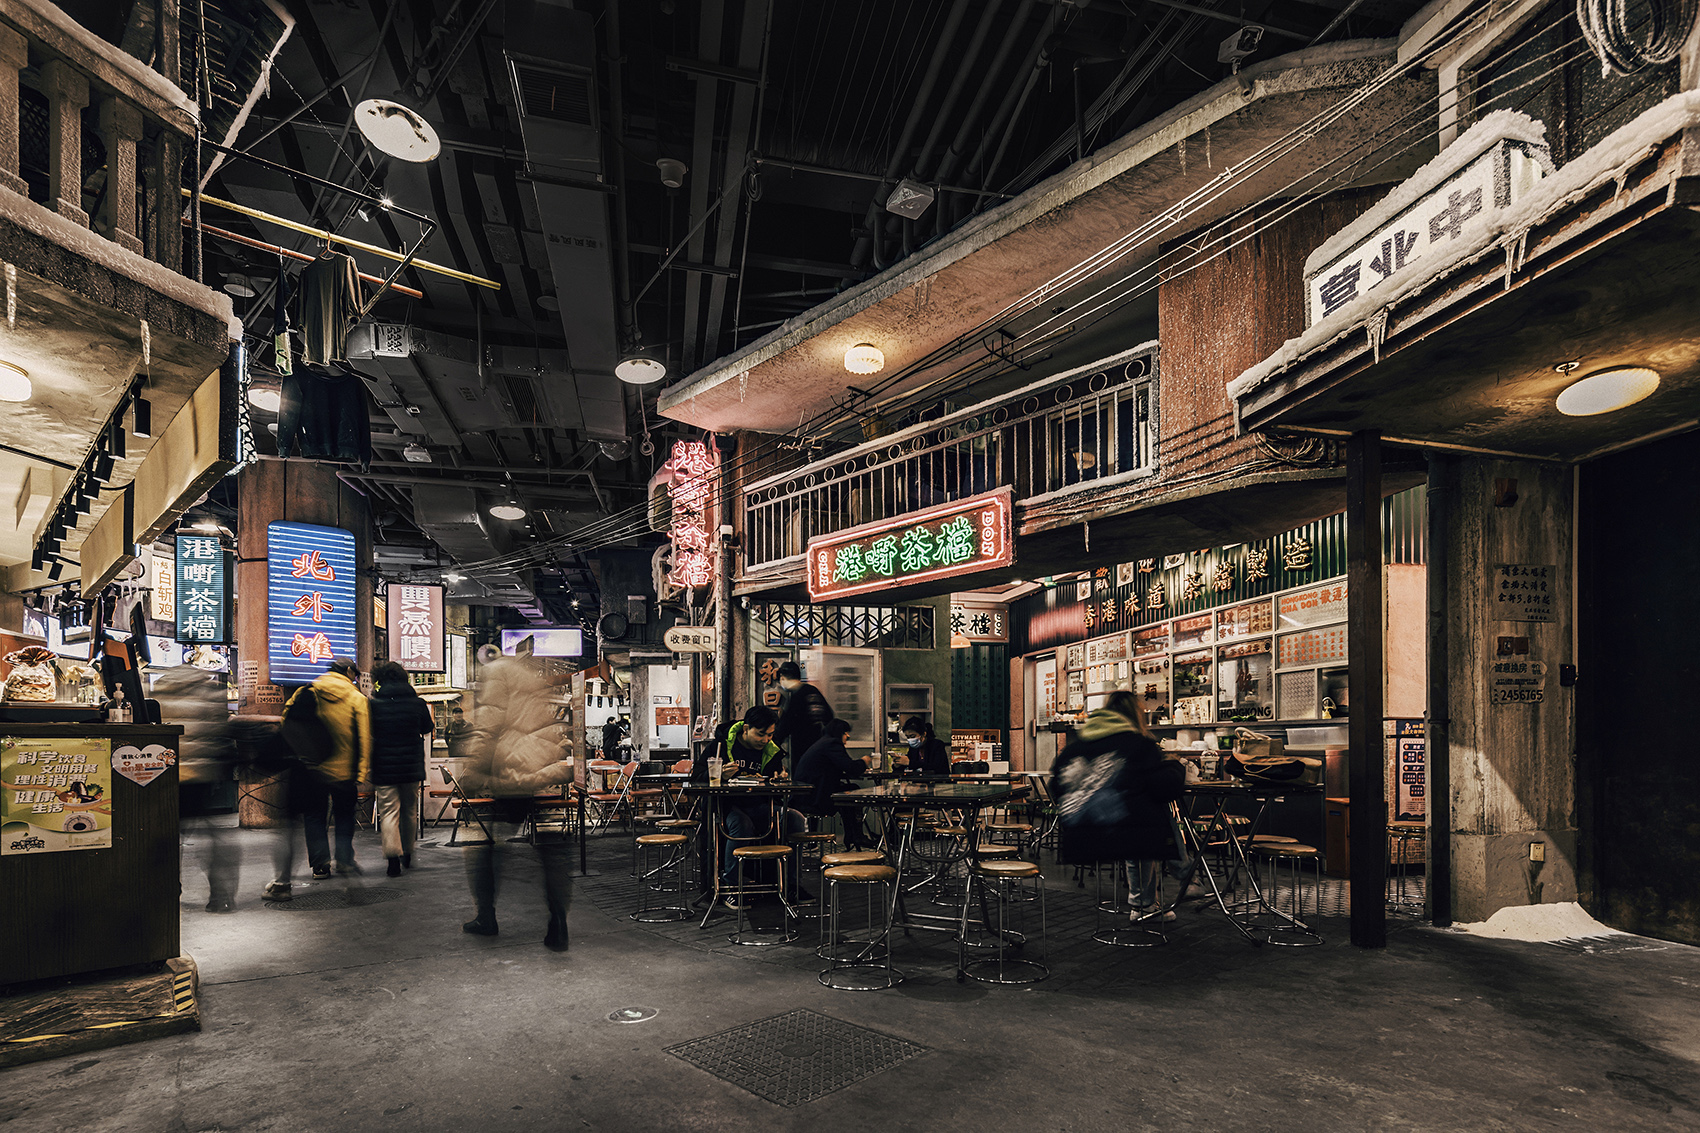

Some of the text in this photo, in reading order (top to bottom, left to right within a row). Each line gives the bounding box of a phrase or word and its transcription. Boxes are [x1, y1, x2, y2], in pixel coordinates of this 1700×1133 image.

[982, 511, 994, 556] DON
[833, 515, 974, 582] 港嘢茶檔
[158, 570, 173, 618] 白斩鸡
[182, 539, 219, 639] 港嘢茶檔
[1281, 591, 1318, 605] HONGKONG
[291, 550, 336, 664] 北外滩
[1281, 599, 1318, 614] CHA DON
[1501, 690, 1543, 701] 2456765
[1220, 706, 1272, 719] HONGKONG
[17, 751, 87, 766] 科学饮食
[40, 764, 99, 774] 文明用餐
[14, 774, 87, 788] 理性消费
[14, 790, 57, 804] 健康
[31, 803, 64, 814] 生活
